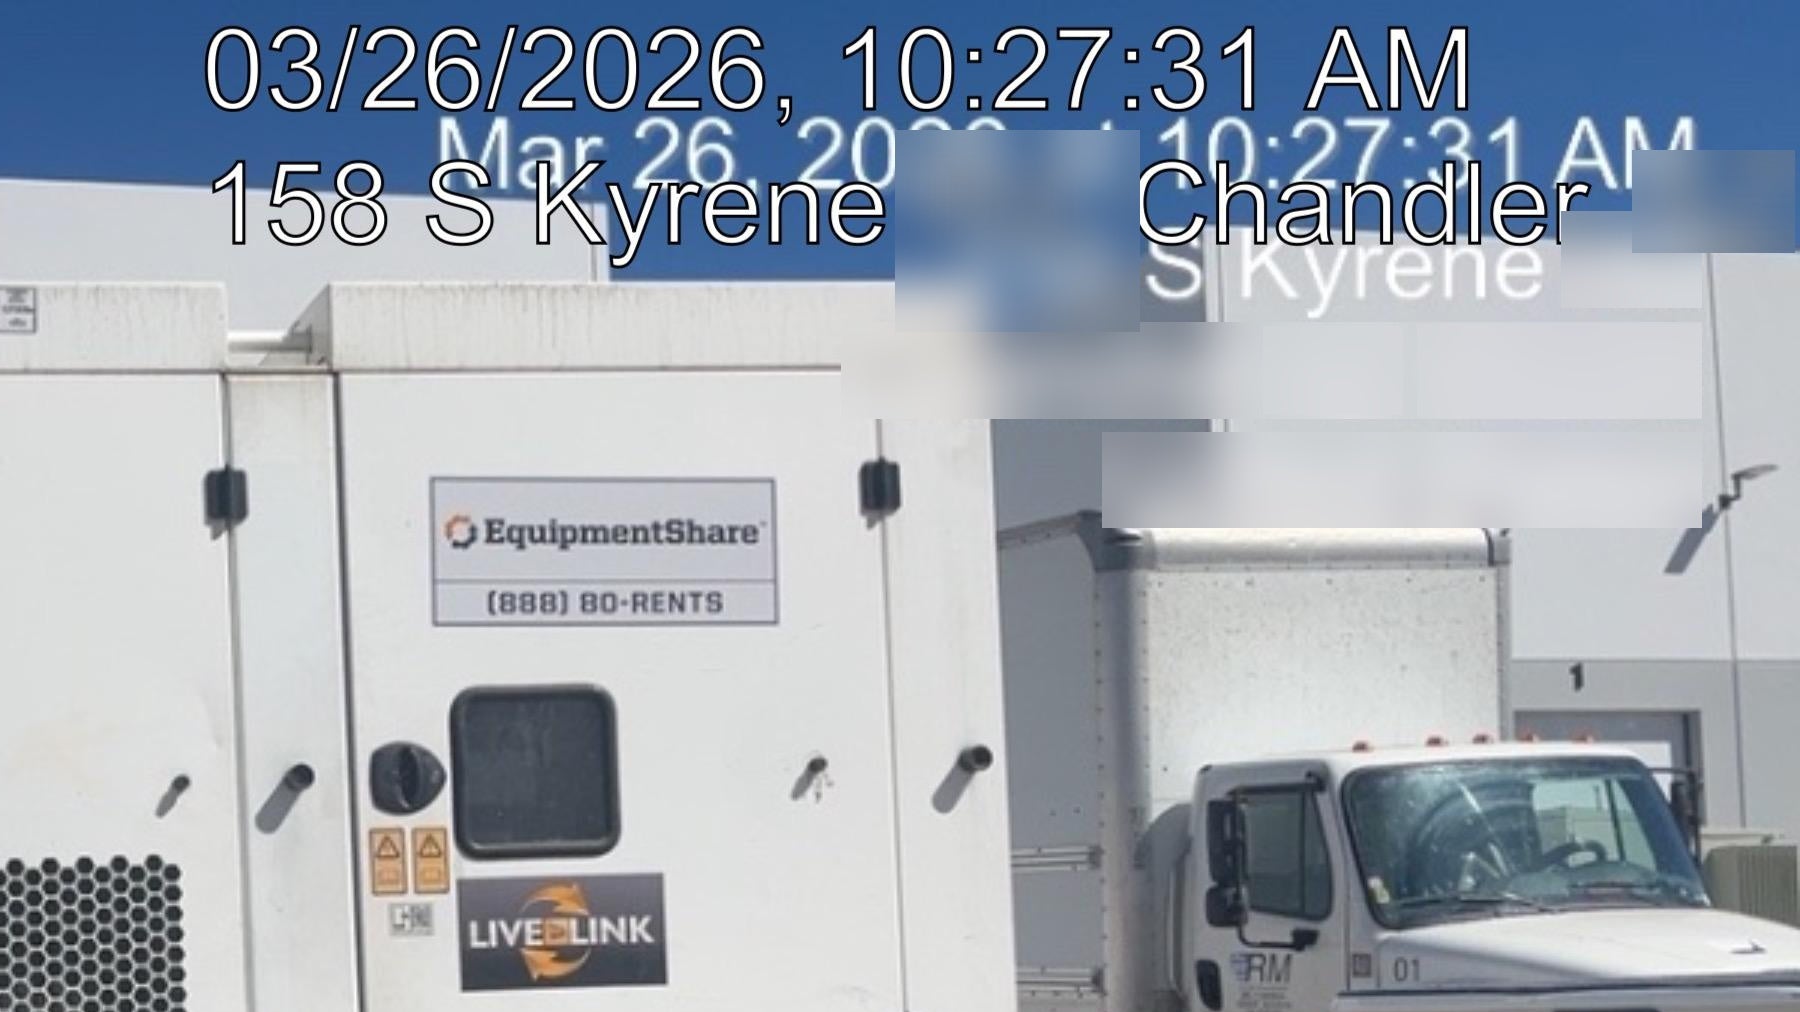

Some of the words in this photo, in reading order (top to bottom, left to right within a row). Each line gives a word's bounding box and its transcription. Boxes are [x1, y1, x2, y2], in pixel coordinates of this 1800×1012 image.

[484, 518, 760, 550] EquipmentShare
[488, 589, 568, 615] (888)
[1569, 662, 1585, 692] 1
